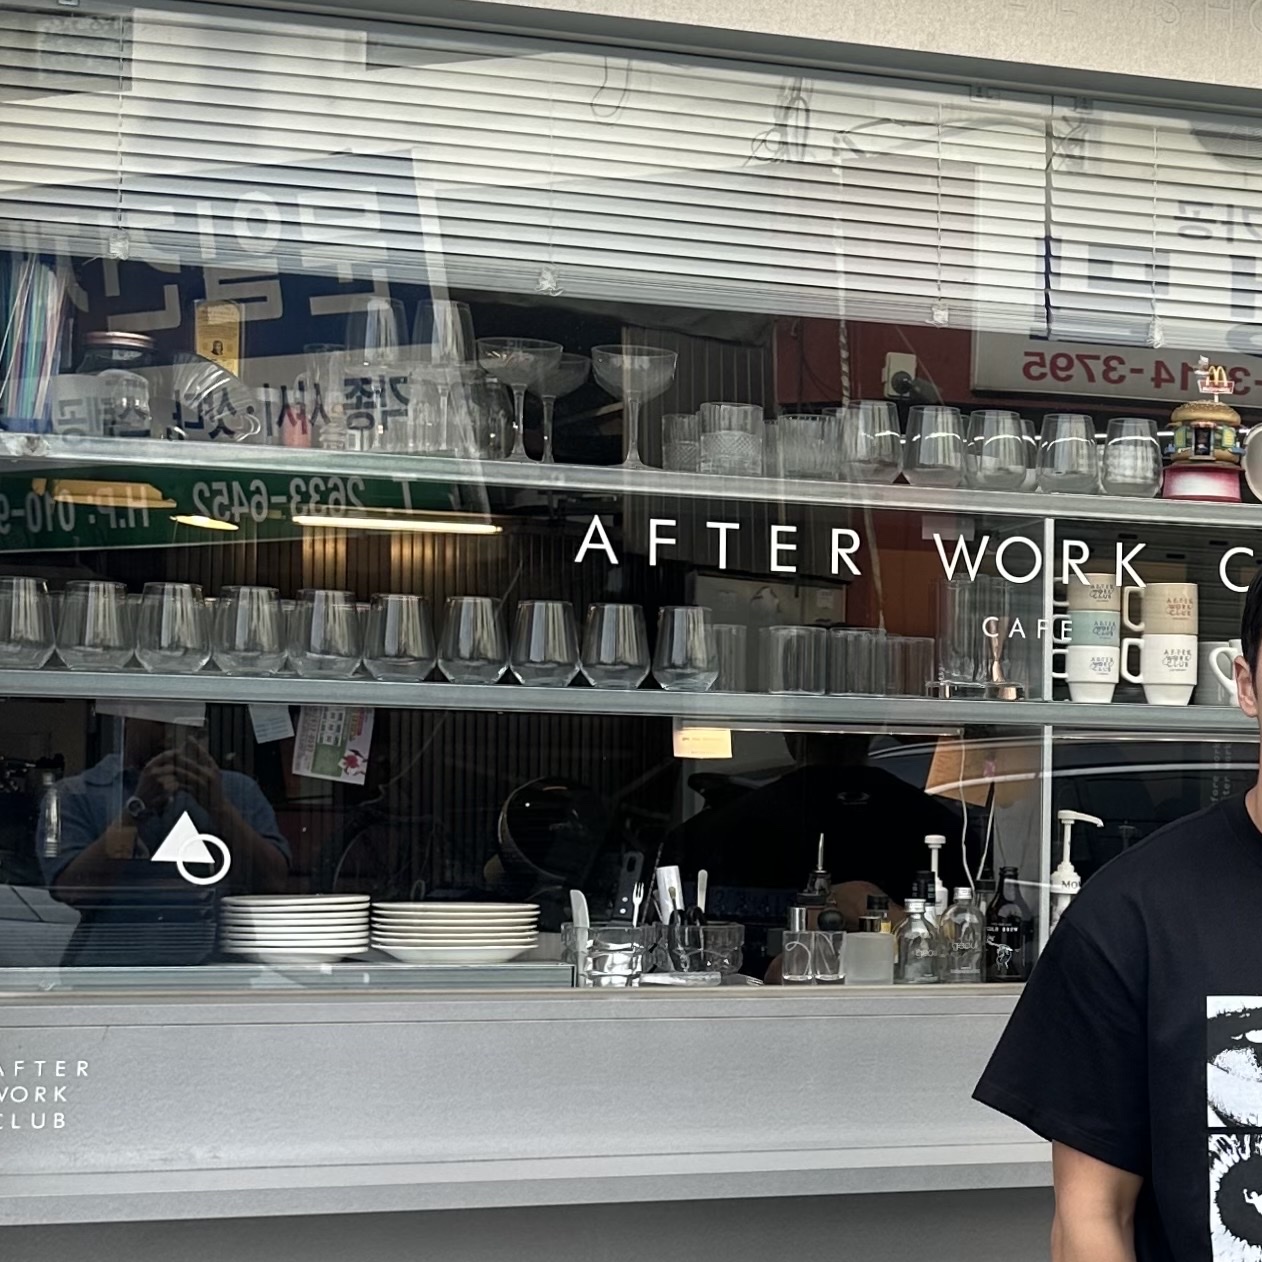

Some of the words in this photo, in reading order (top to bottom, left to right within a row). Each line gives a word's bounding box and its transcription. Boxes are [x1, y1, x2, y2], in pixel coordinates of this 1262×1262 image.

[574, 514, 862, 577] AFTER
[933, 533, 1146, 589] WORK
[0, 1112, 65, 1130] LUB
